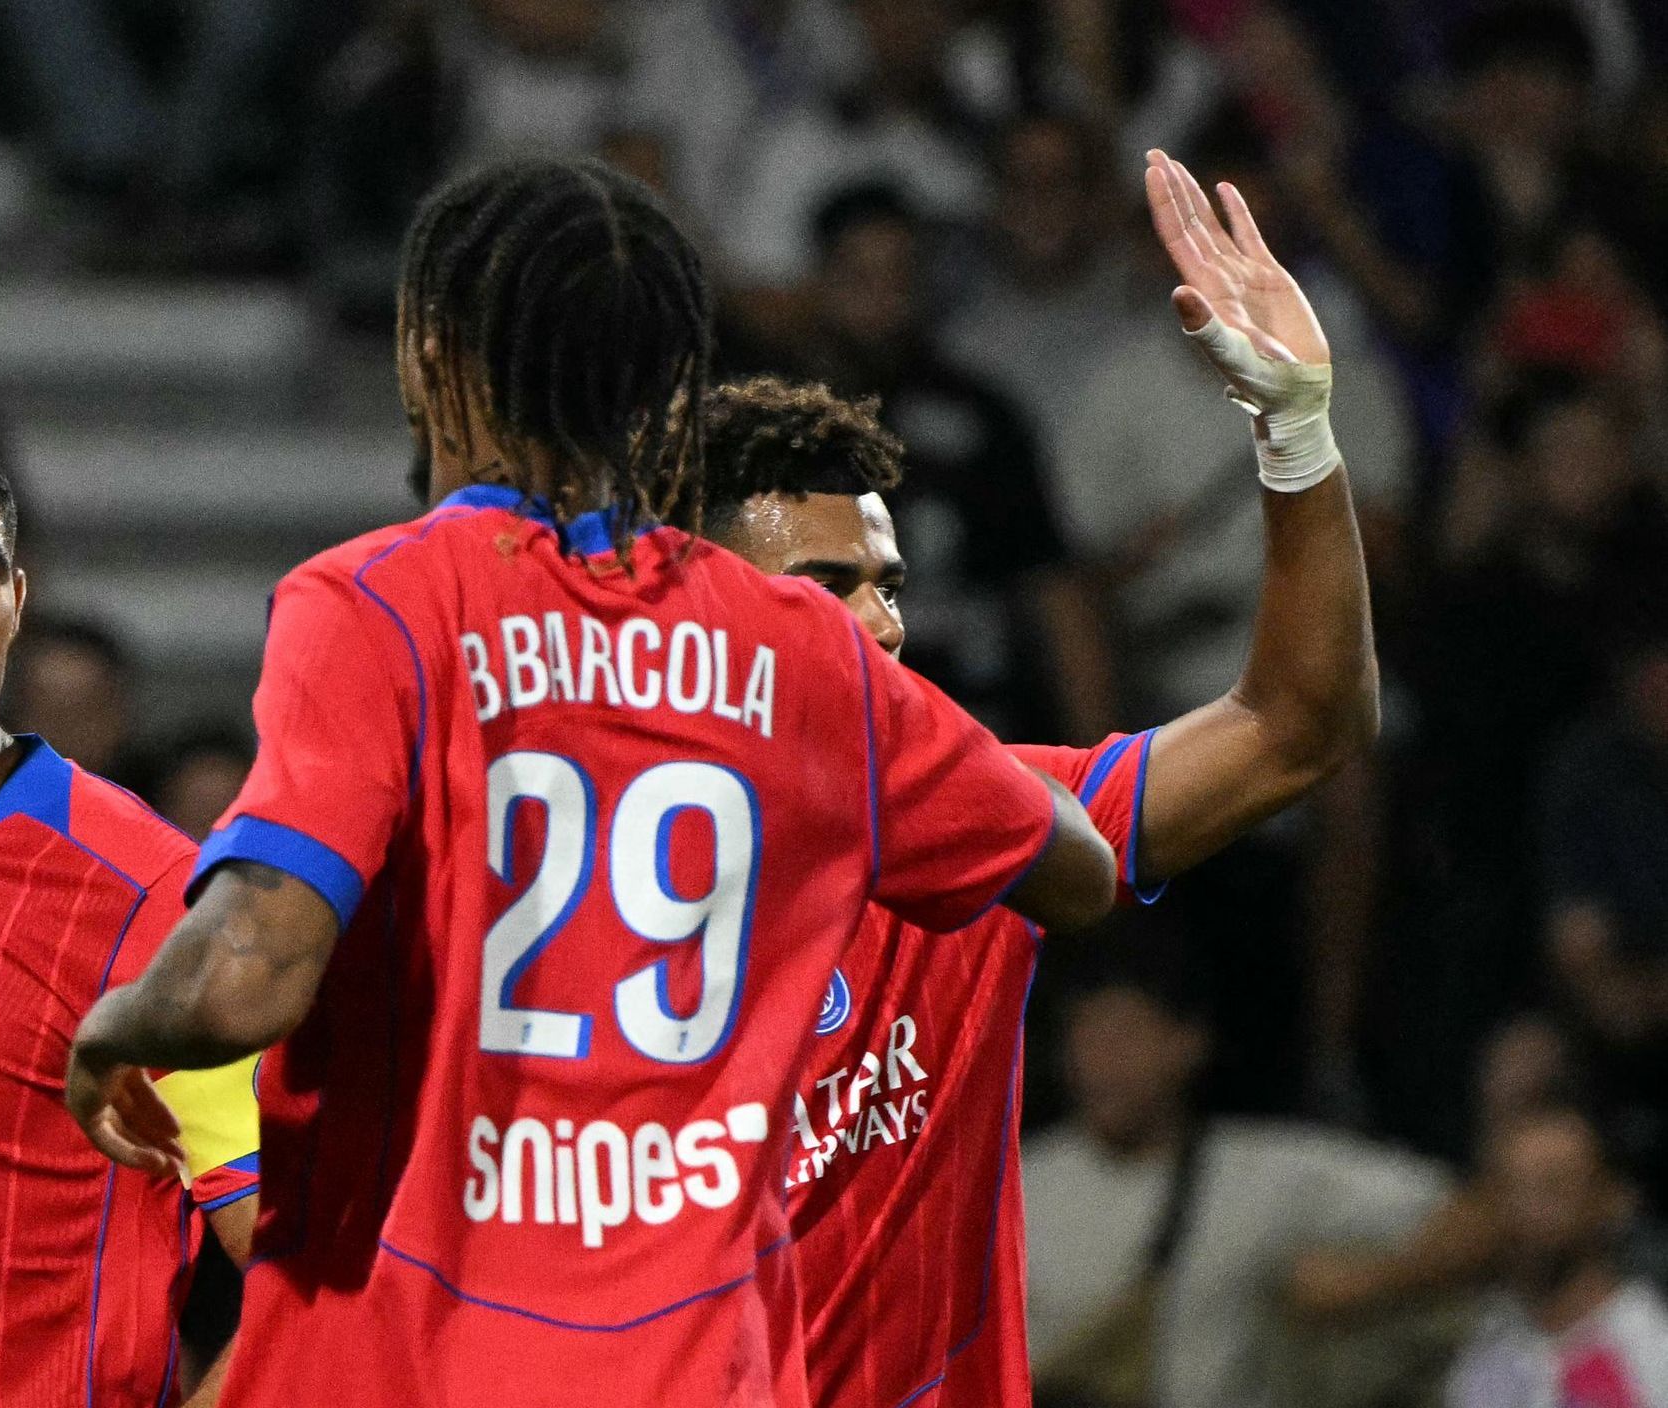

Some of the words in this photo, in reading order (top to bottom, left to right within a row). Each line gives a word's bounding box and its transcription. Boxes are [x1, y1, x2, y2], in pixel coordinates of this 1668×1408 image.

[477, 750, 762, 1064] 29
[784, 1089, 929, 1190] IRWAYS
[790, 1014, 930, 1150] ATAR
[464, 1114, 742, 1249] snipes
